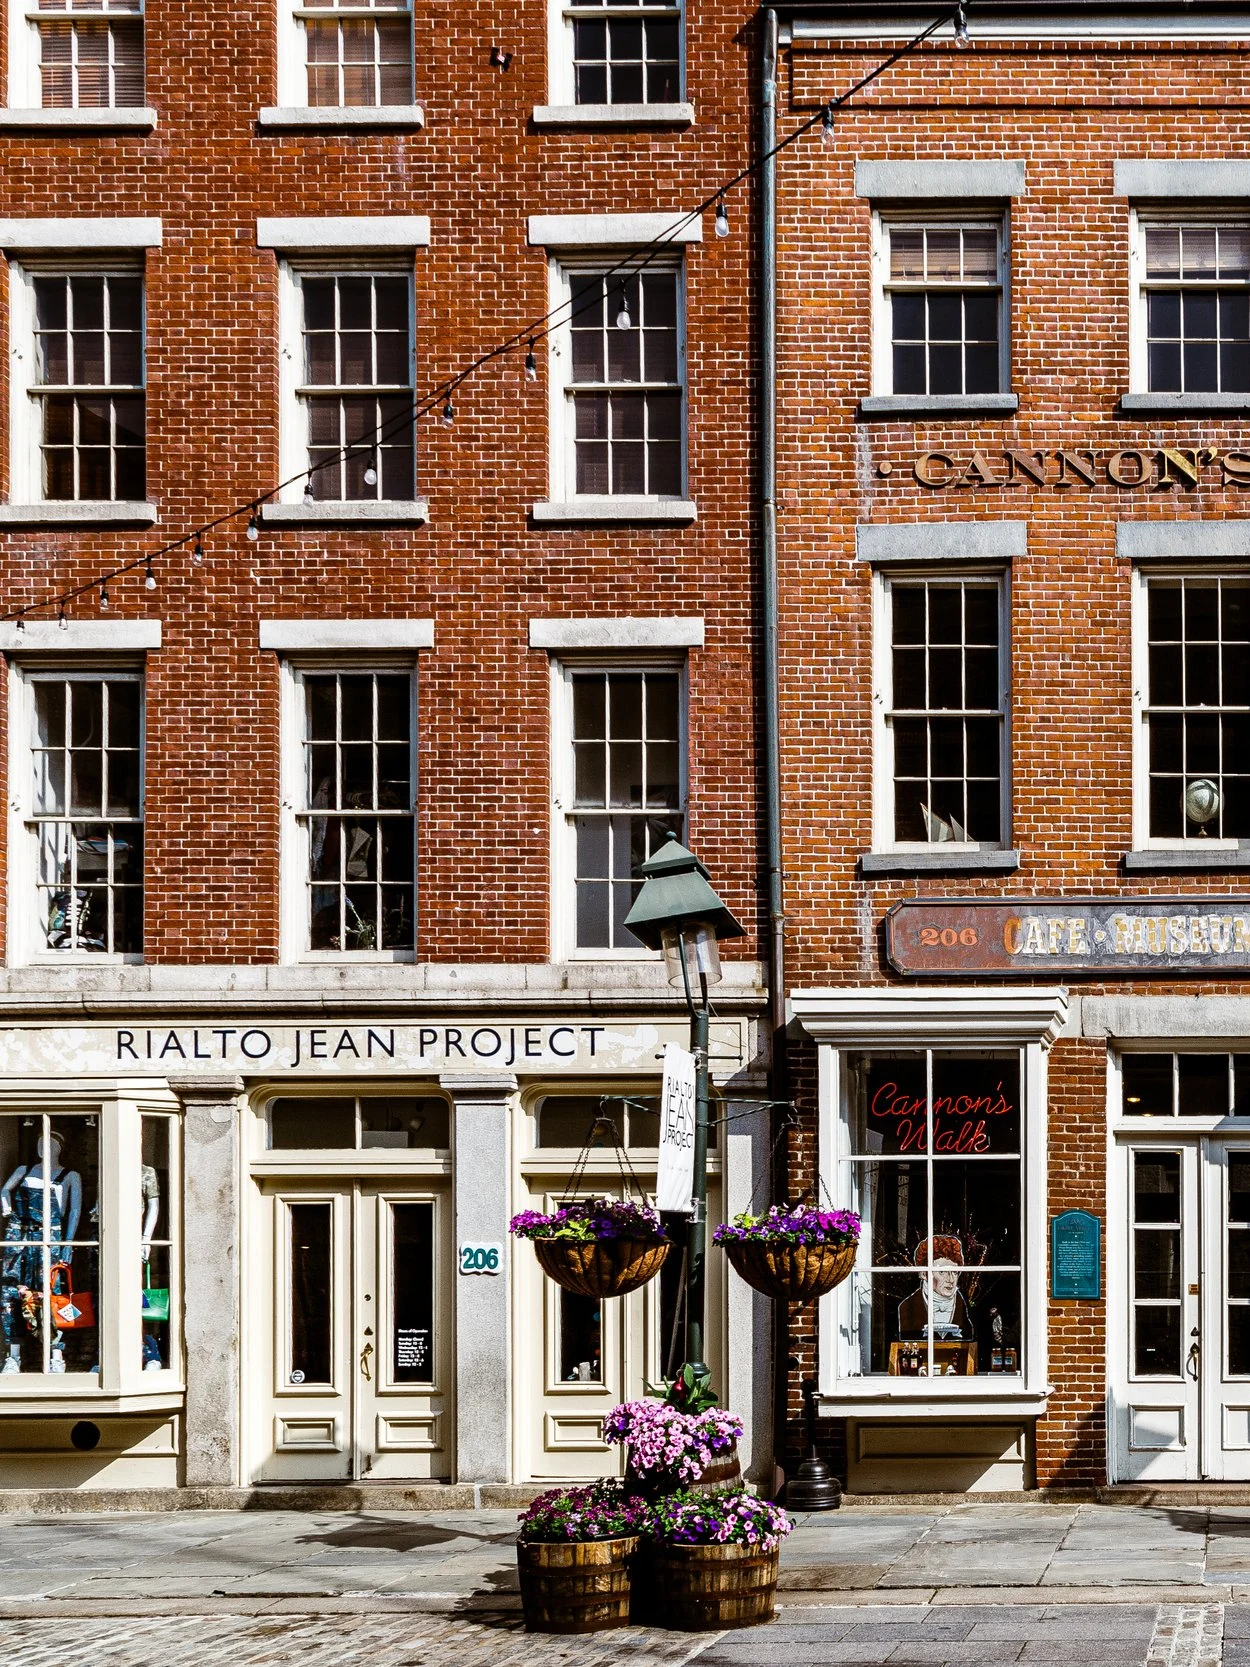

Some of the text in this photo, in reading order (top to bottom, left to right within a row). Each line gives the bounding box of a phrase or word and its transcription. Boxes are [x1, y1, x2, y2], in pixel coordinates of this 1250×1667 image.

[919, 927, 978, 947] 206
[1003, 916, 1089, 955] CAFE
[117, 1027, 605, 1068] RIALTO JEAN PROJECT
[667, 1075, 693, 1099] RIALTO
[871, 1081, 1013, 1117] Cannon's
[663, 1093, 694, 1144] JEAN
[896, 1118, 990, 1152] Walk
[462, 1247, 499, 1270] 206
